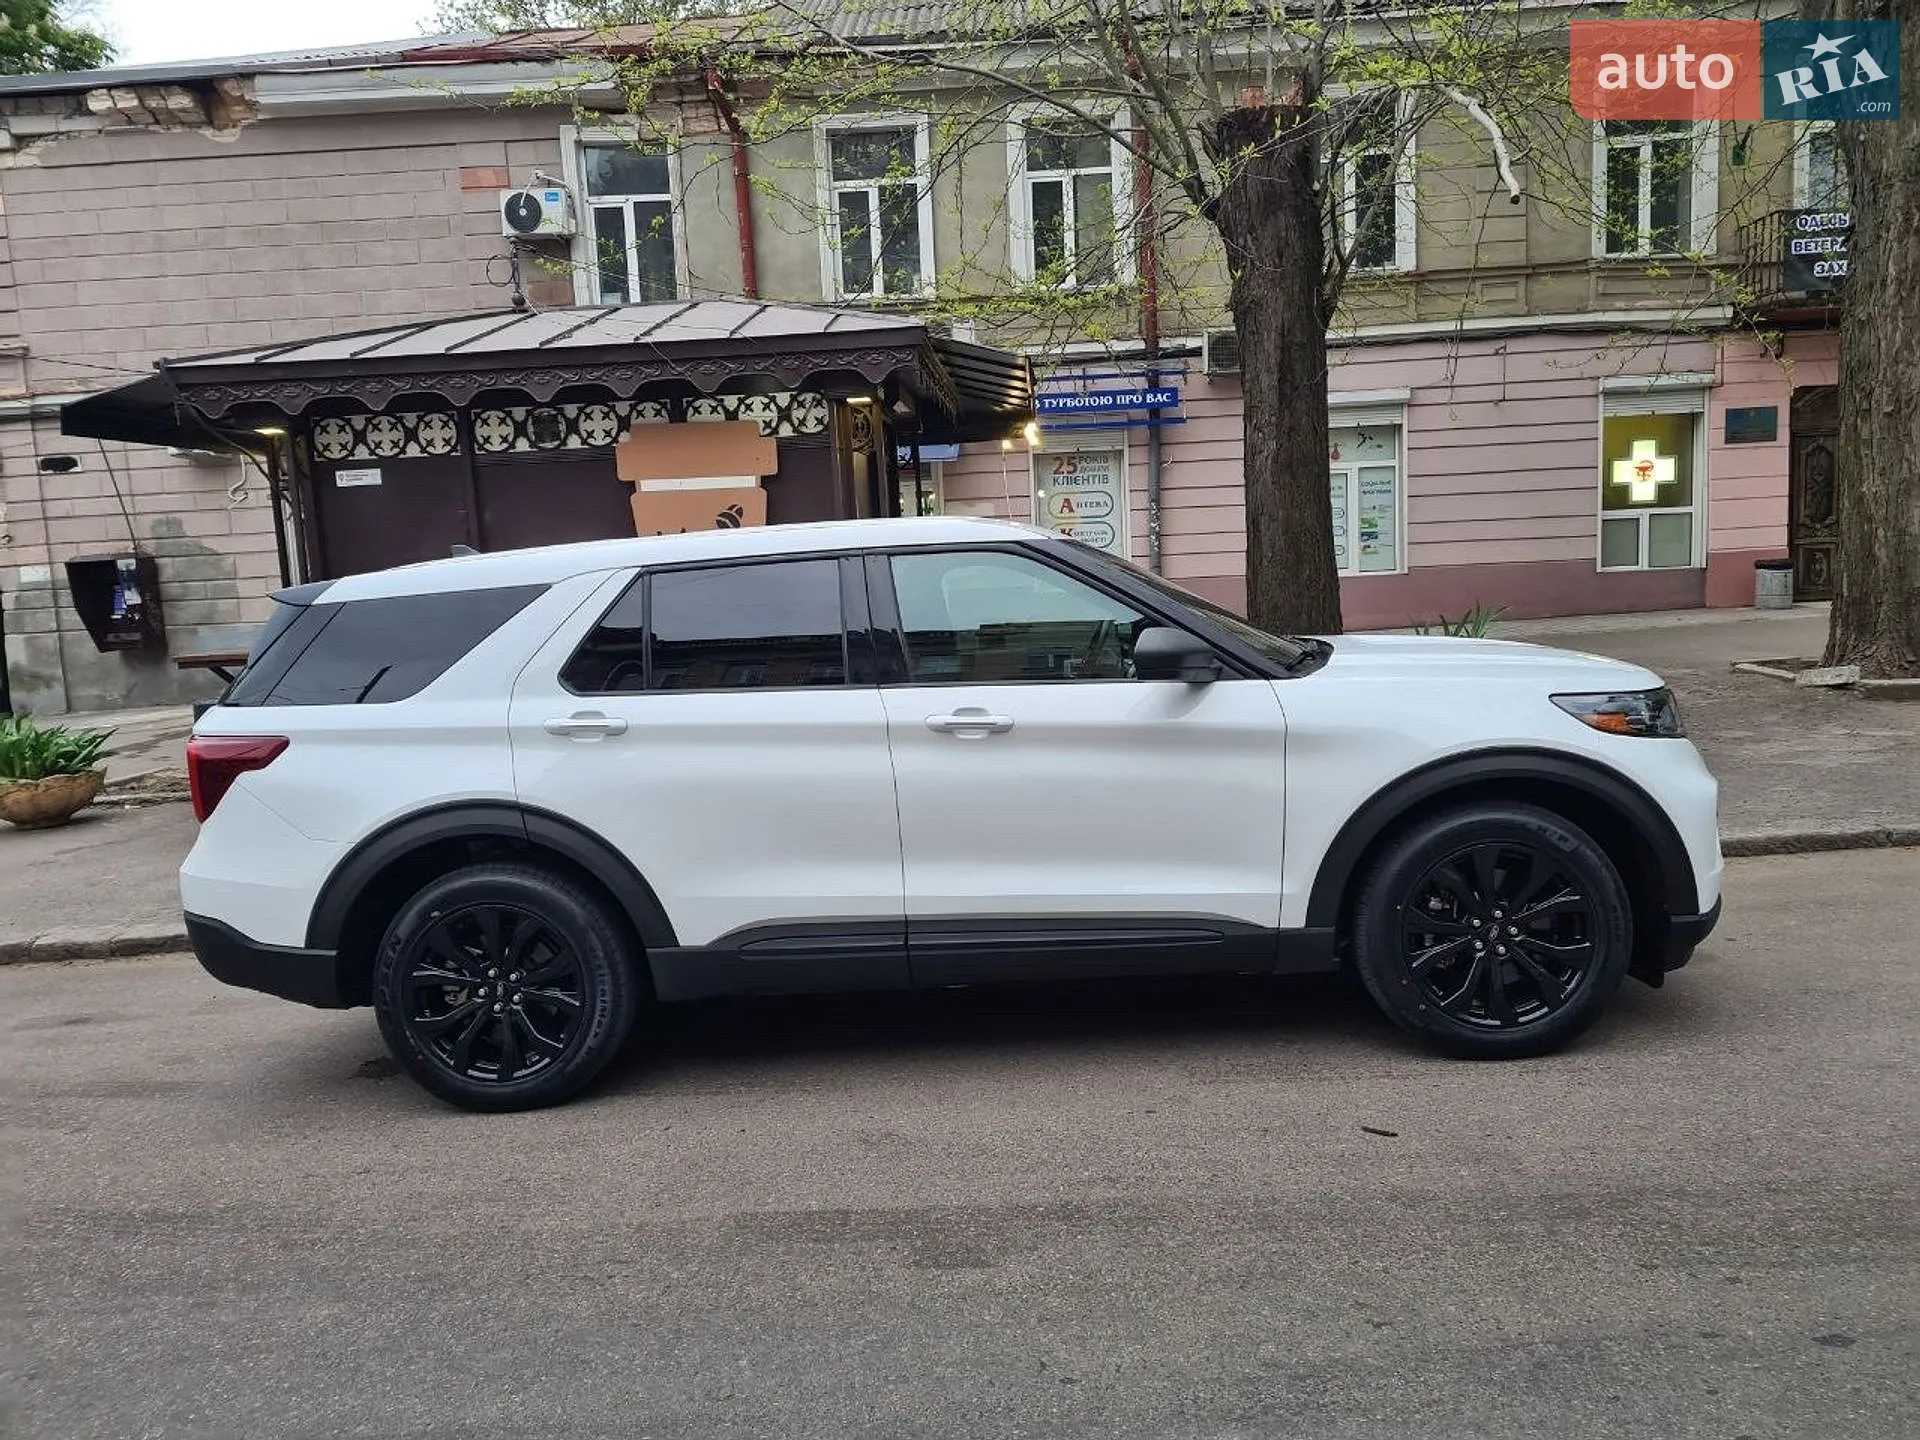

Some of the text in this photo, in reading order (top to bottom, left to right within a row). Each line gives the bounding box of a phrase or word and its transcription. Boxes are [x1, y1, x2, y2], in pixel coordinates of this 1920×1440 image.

[1044, 396, 1113, 408] ТУРБОТОЮ
[1116, 393, 1142, 405] ПРО
[1146, 392, 1172, 403] ВАС
[1053, 456, 1078, 474] 25
[1052, 474, 1109, 486] КЛІЄНТІВ
